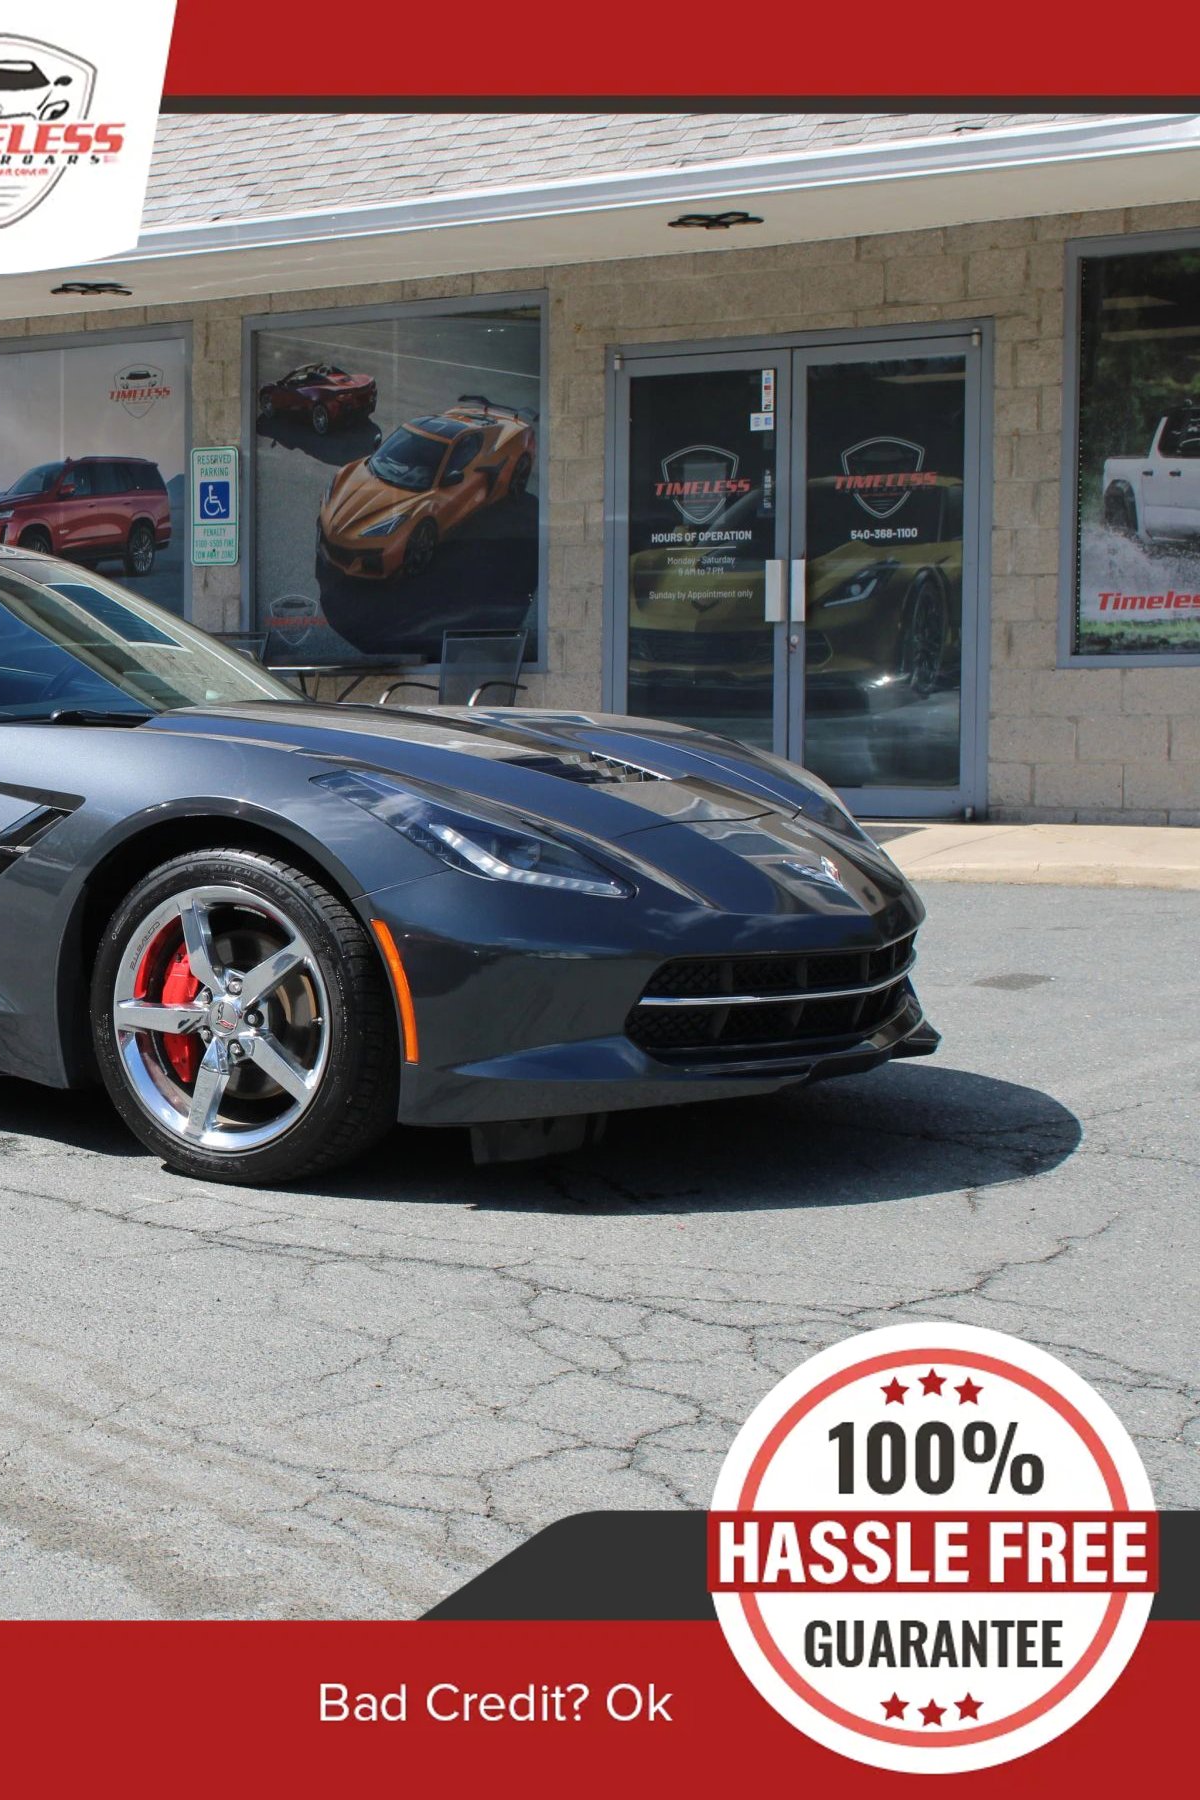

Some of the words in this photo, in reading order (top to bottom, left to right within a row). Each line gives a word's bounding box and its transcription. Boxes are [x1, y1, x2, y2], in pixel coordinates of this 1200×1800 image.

[108, 386, 172, 400] TIMELESS
[197, 454, 232, 465] RESERVED
[200, 467, 229, 477] PARKING
[654, 478, 751, 496] TIMELESS
[835, 472, 937, 490] TIMELESS
[651, 533, 683, 543] HOURS
[684, 532, 697, 541] OF
[698, 530, 752, 541] OPERATION
[850, 527, 918, 540] 540-368-1100
[667, 557, 696, 566] Monday
[702, 556, 736, 565] Saturday
[697, 567, 705, 576] to
[712, 566, 724, 575] PM
[649, 591, 676, 601] Sunday
[677, 591, 686, 601] by
[687, 590, 736, 600] Appointment
[737, 589, 754, 599] only
